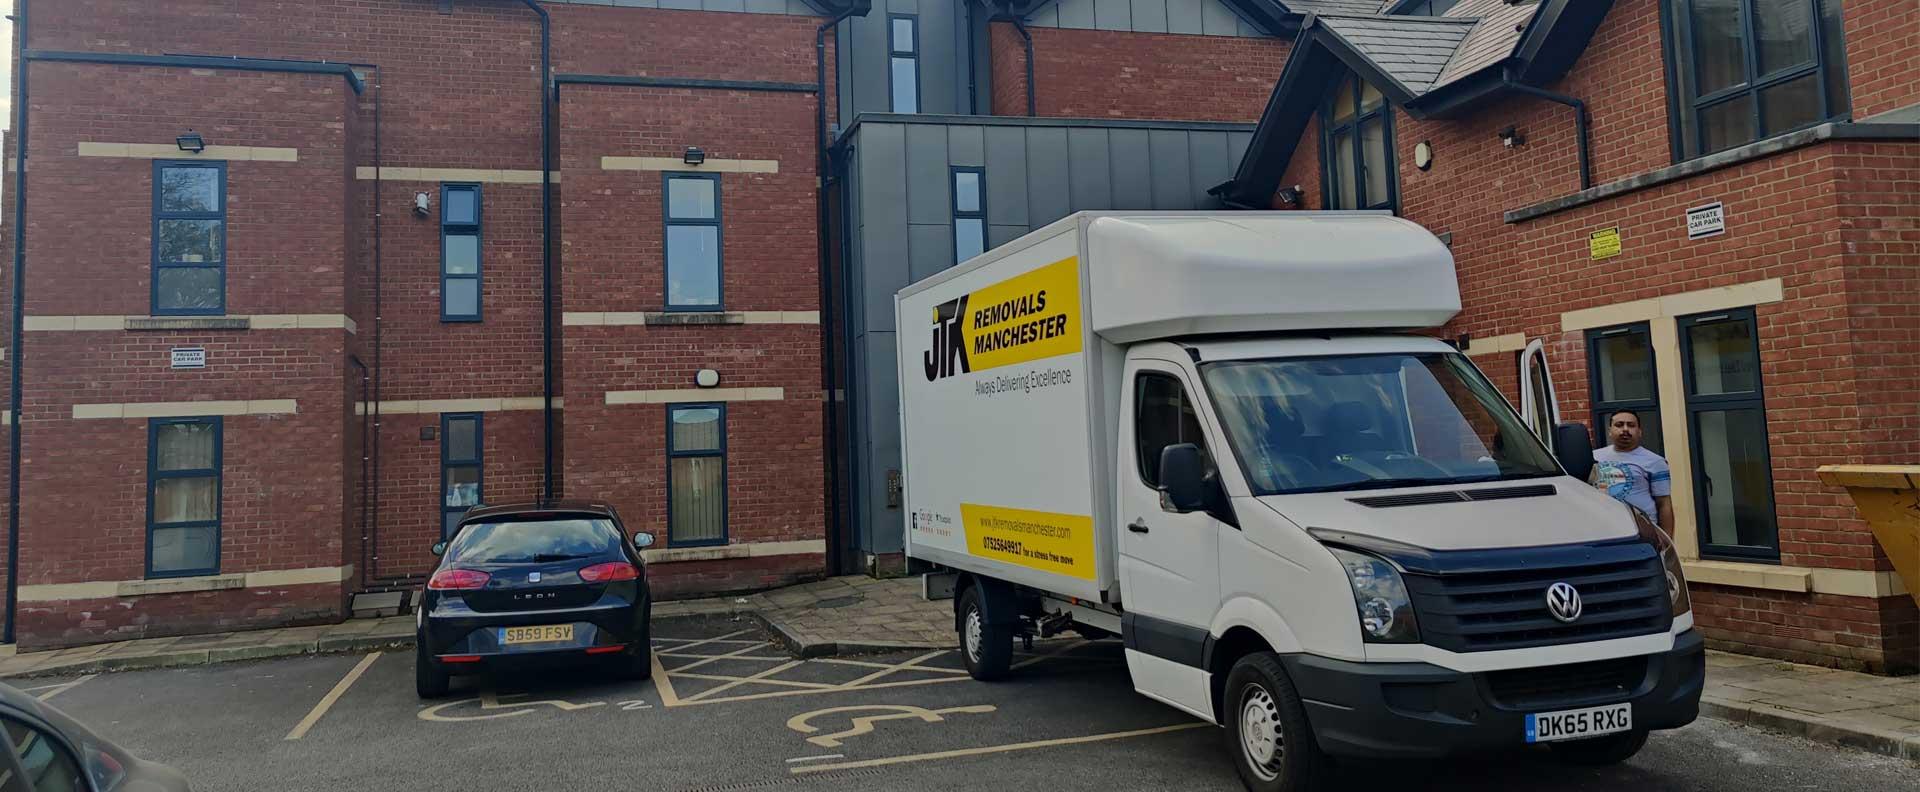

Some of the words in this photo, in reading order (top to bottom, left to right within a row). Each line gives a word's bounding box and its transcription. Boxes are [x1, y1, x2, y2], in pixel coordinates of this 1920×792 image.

[1690, 220, 1703, 229] CAR
[1703, 217, 1722, 226] PARK
[1691, 211, 1717, 221] PRIVATE
[973, 289, 1047, 330] REMOVALS
[973, 312, 1067, 356] MANCHESTER
[975, 378, 996, 397] Always
[996, 373, 1030, 394] Delivering
[1031, 368, 1072, 389] Excellence
[983, 536, 1022, 555] 07525649917
[1034, 551, 1049, 560] stress
[1049, 552, 1060, 563] free
[1060, 556, 1074, 565] move
[513, 592, 556, 600] LEON
[507, 628, 542, 641] SB59
[545, 626, 571, 639] FSV
[1539, 712, 1588, 737] DK65
[1593, 708, 1628, 731] RXG
